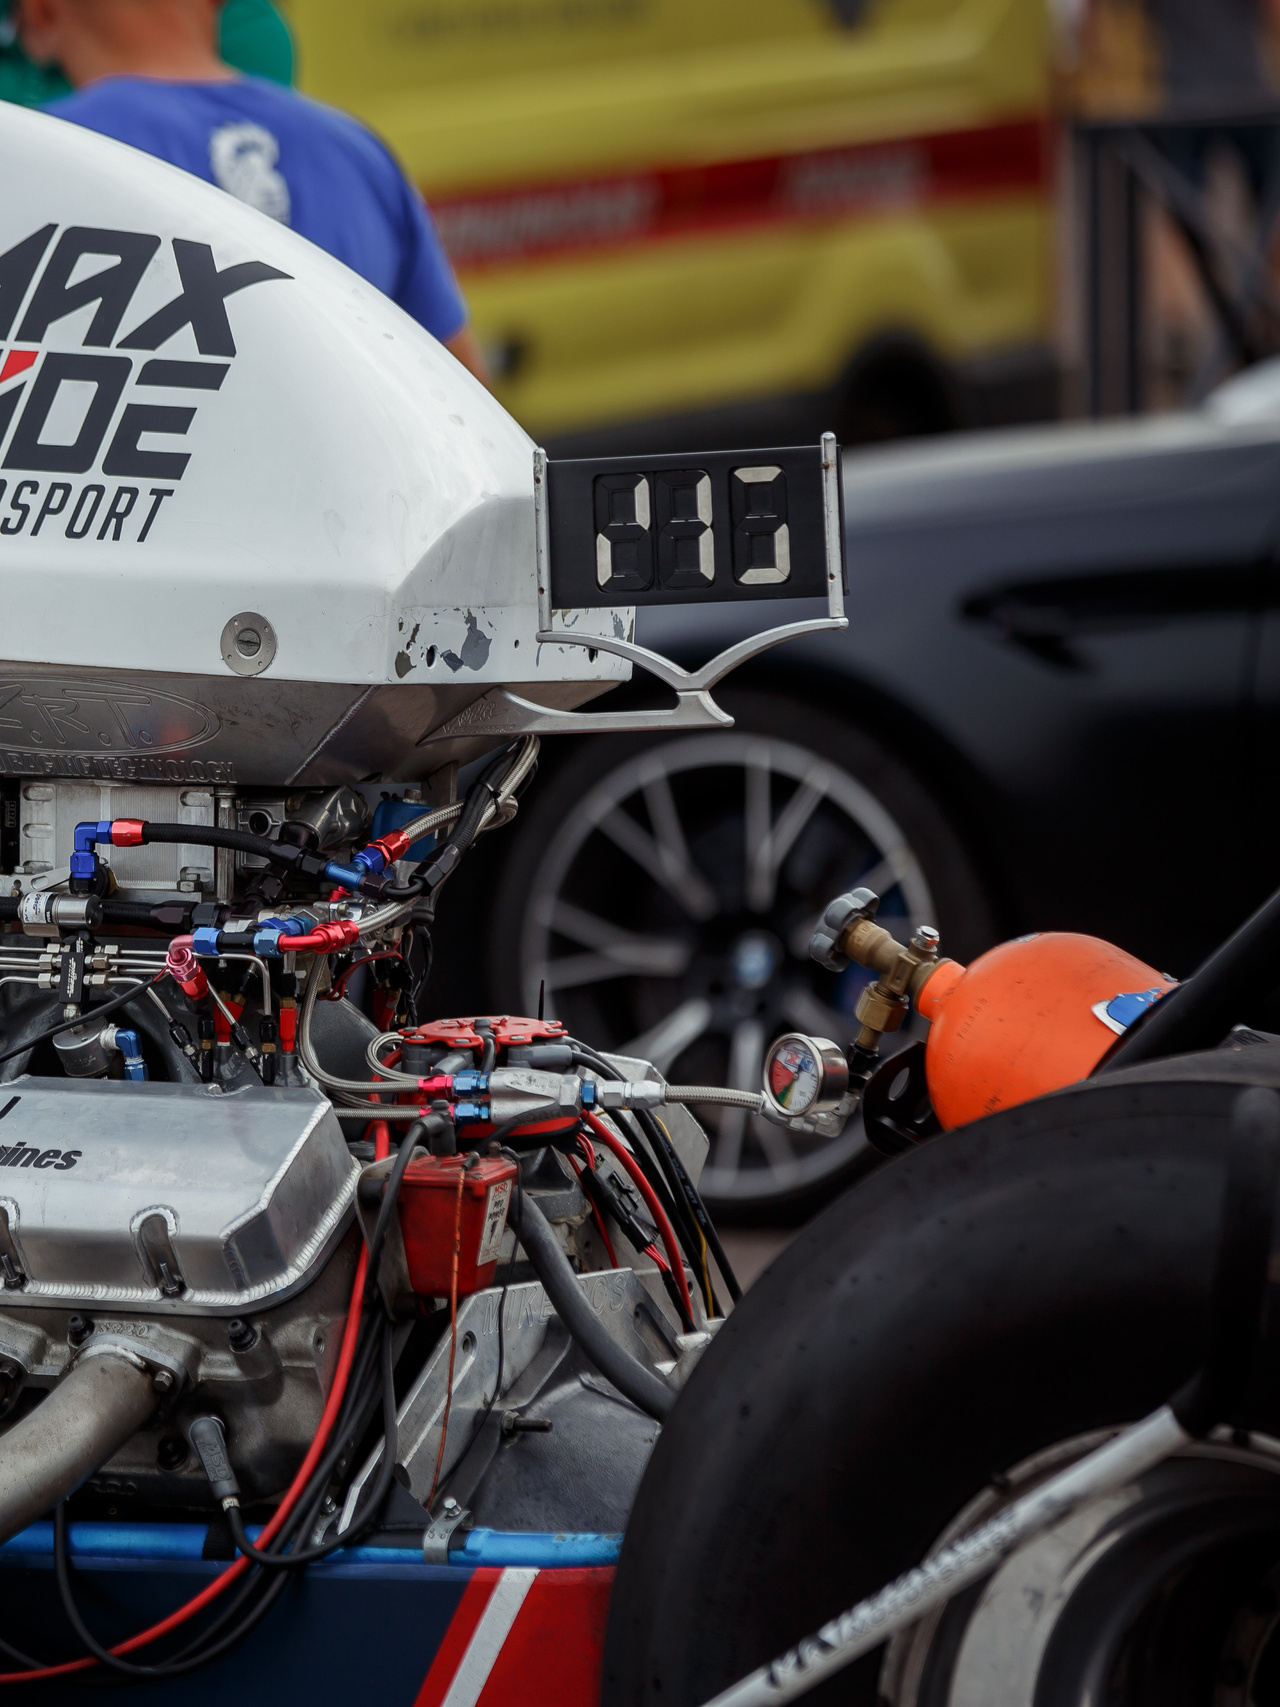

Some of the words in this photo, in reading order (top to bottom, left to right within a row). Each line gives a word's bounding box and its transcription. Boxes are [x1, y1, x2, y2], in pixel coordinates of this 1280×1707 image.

[6, 752, 94, 778] RACING
[93, 757, 237, 784] TECHNOLOGY
[481, 1286, 554, 1336] MIKE
